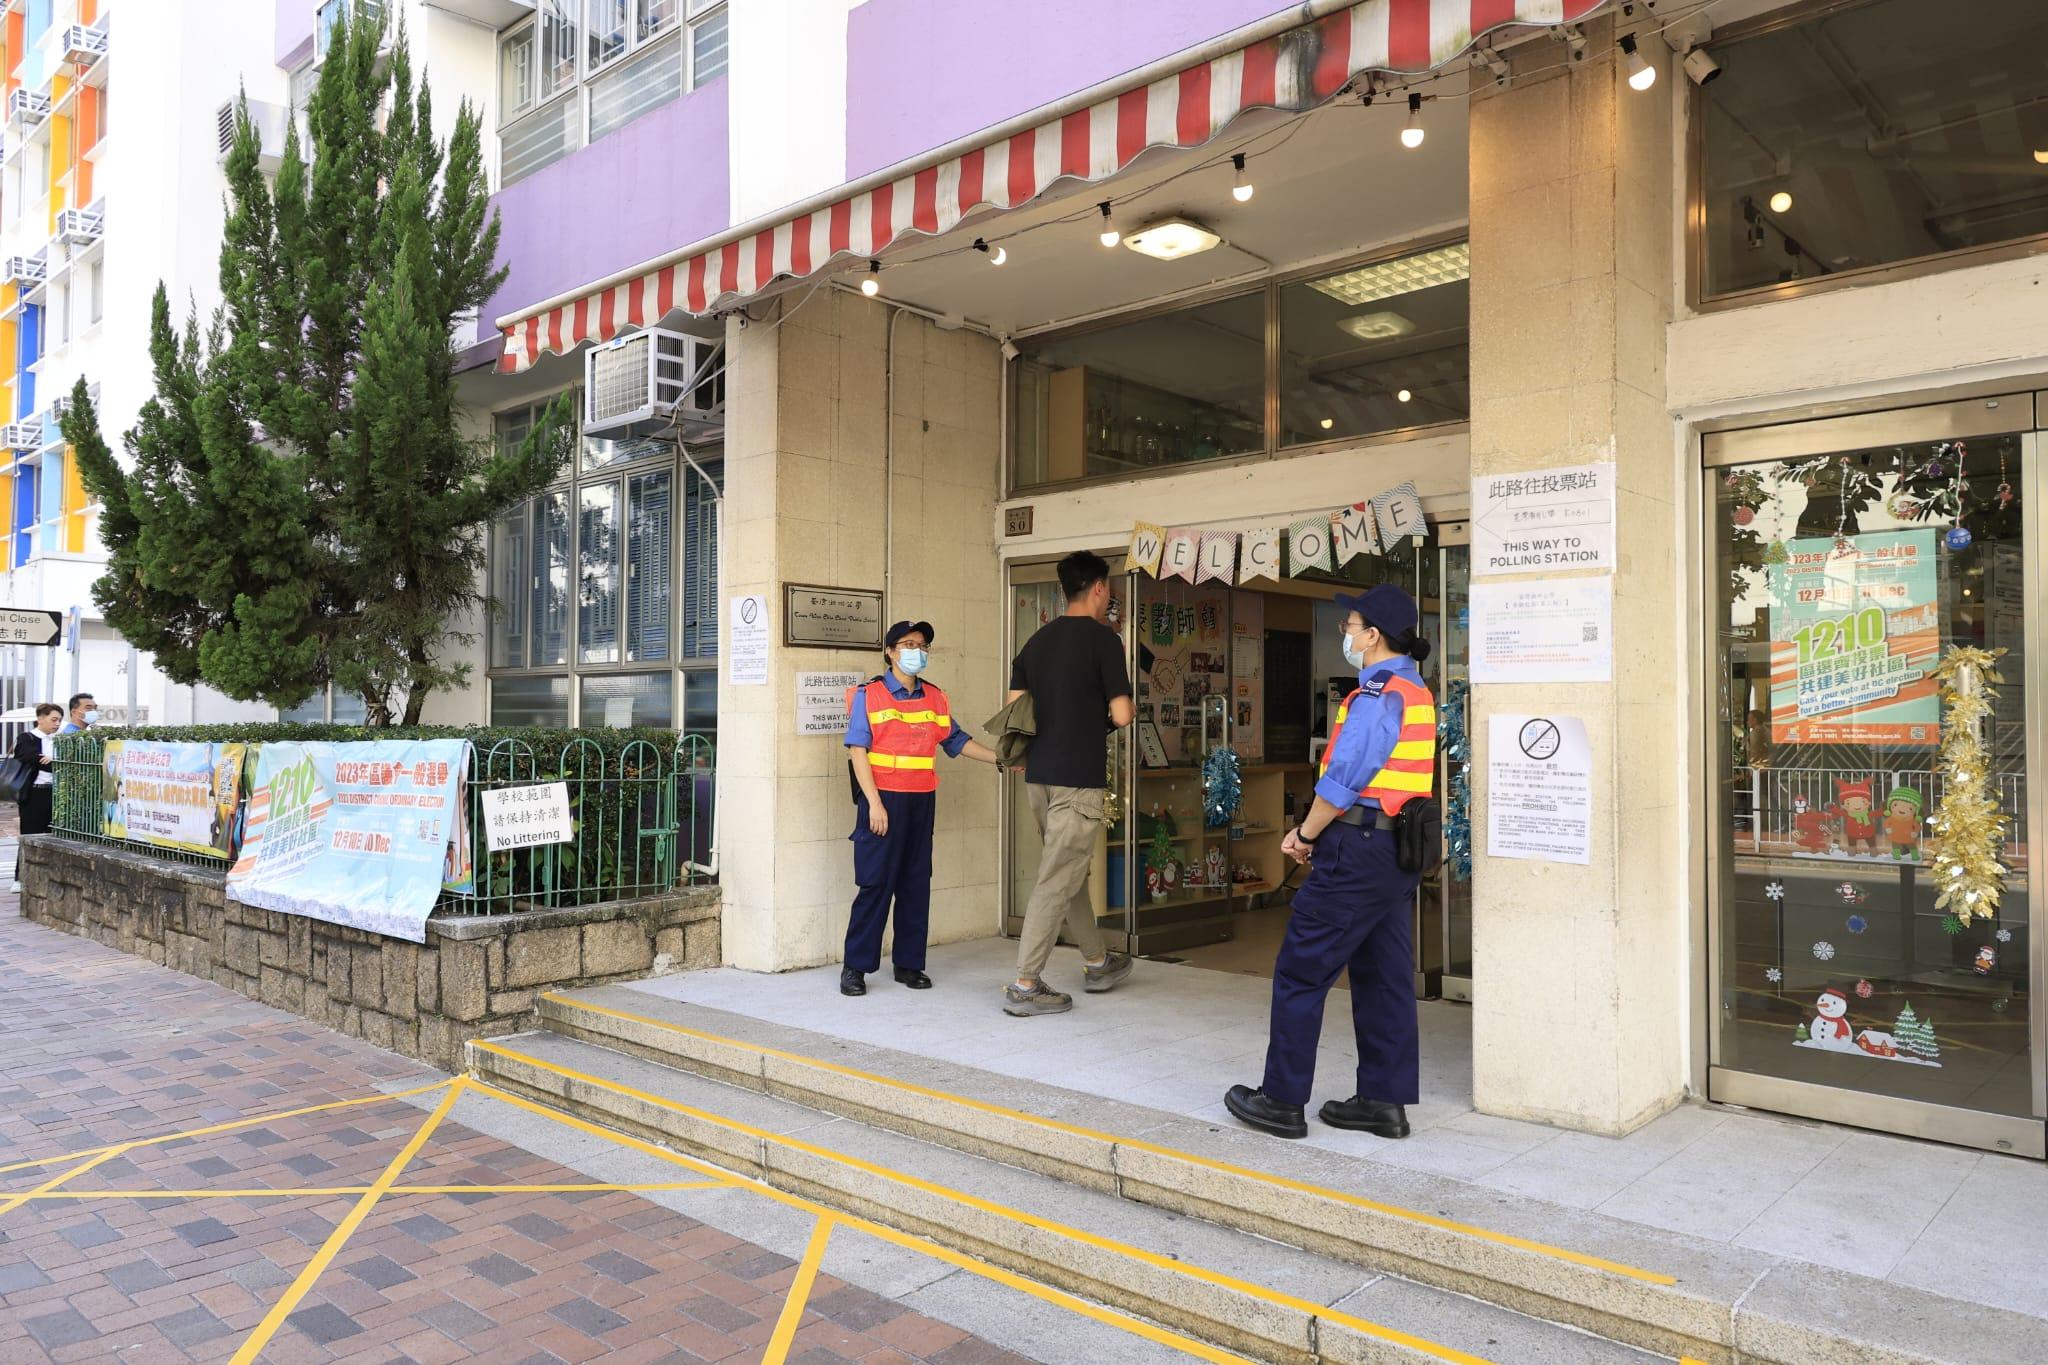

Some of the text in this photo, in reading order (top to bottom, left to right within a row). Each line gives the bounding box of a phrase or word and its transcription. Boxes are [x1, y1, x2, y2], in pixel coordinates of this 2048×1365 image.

[1489, 471, 1598, 499] 此路往投票站
[1135, 500, 1404, 568] WELCOME
[1502, 537, 1581, 552] THIS WAY TO
[1490, 550, 1599, 567] POLLING STATION
[10, 613, 41, 623] Close
[1793, 609, 1884, 663] 1210
[1800, 645, 1886, 680] 區選齊投票
[804, 675, 857, 687] 此路往投票站
[1800, 656, 1905, 694] 共建美好社區
[1861, 682, 1870, 691] at
[1886, 671, 1921, 684] election
[1801, 705, 1812, 715] for
[1822, 699, 1846, 710] better
[1849, 687, 1897, 703] community
[805, 723, 832, 731] POLLING
[267, 753, 317, 822] 1210
[497, 786, 552, 805] 學校範圍
[493, 806, 560, 828] 請保持清潔
[375, 834, 391, 854] Dec
[497, 830, 560, 846] No Littering
